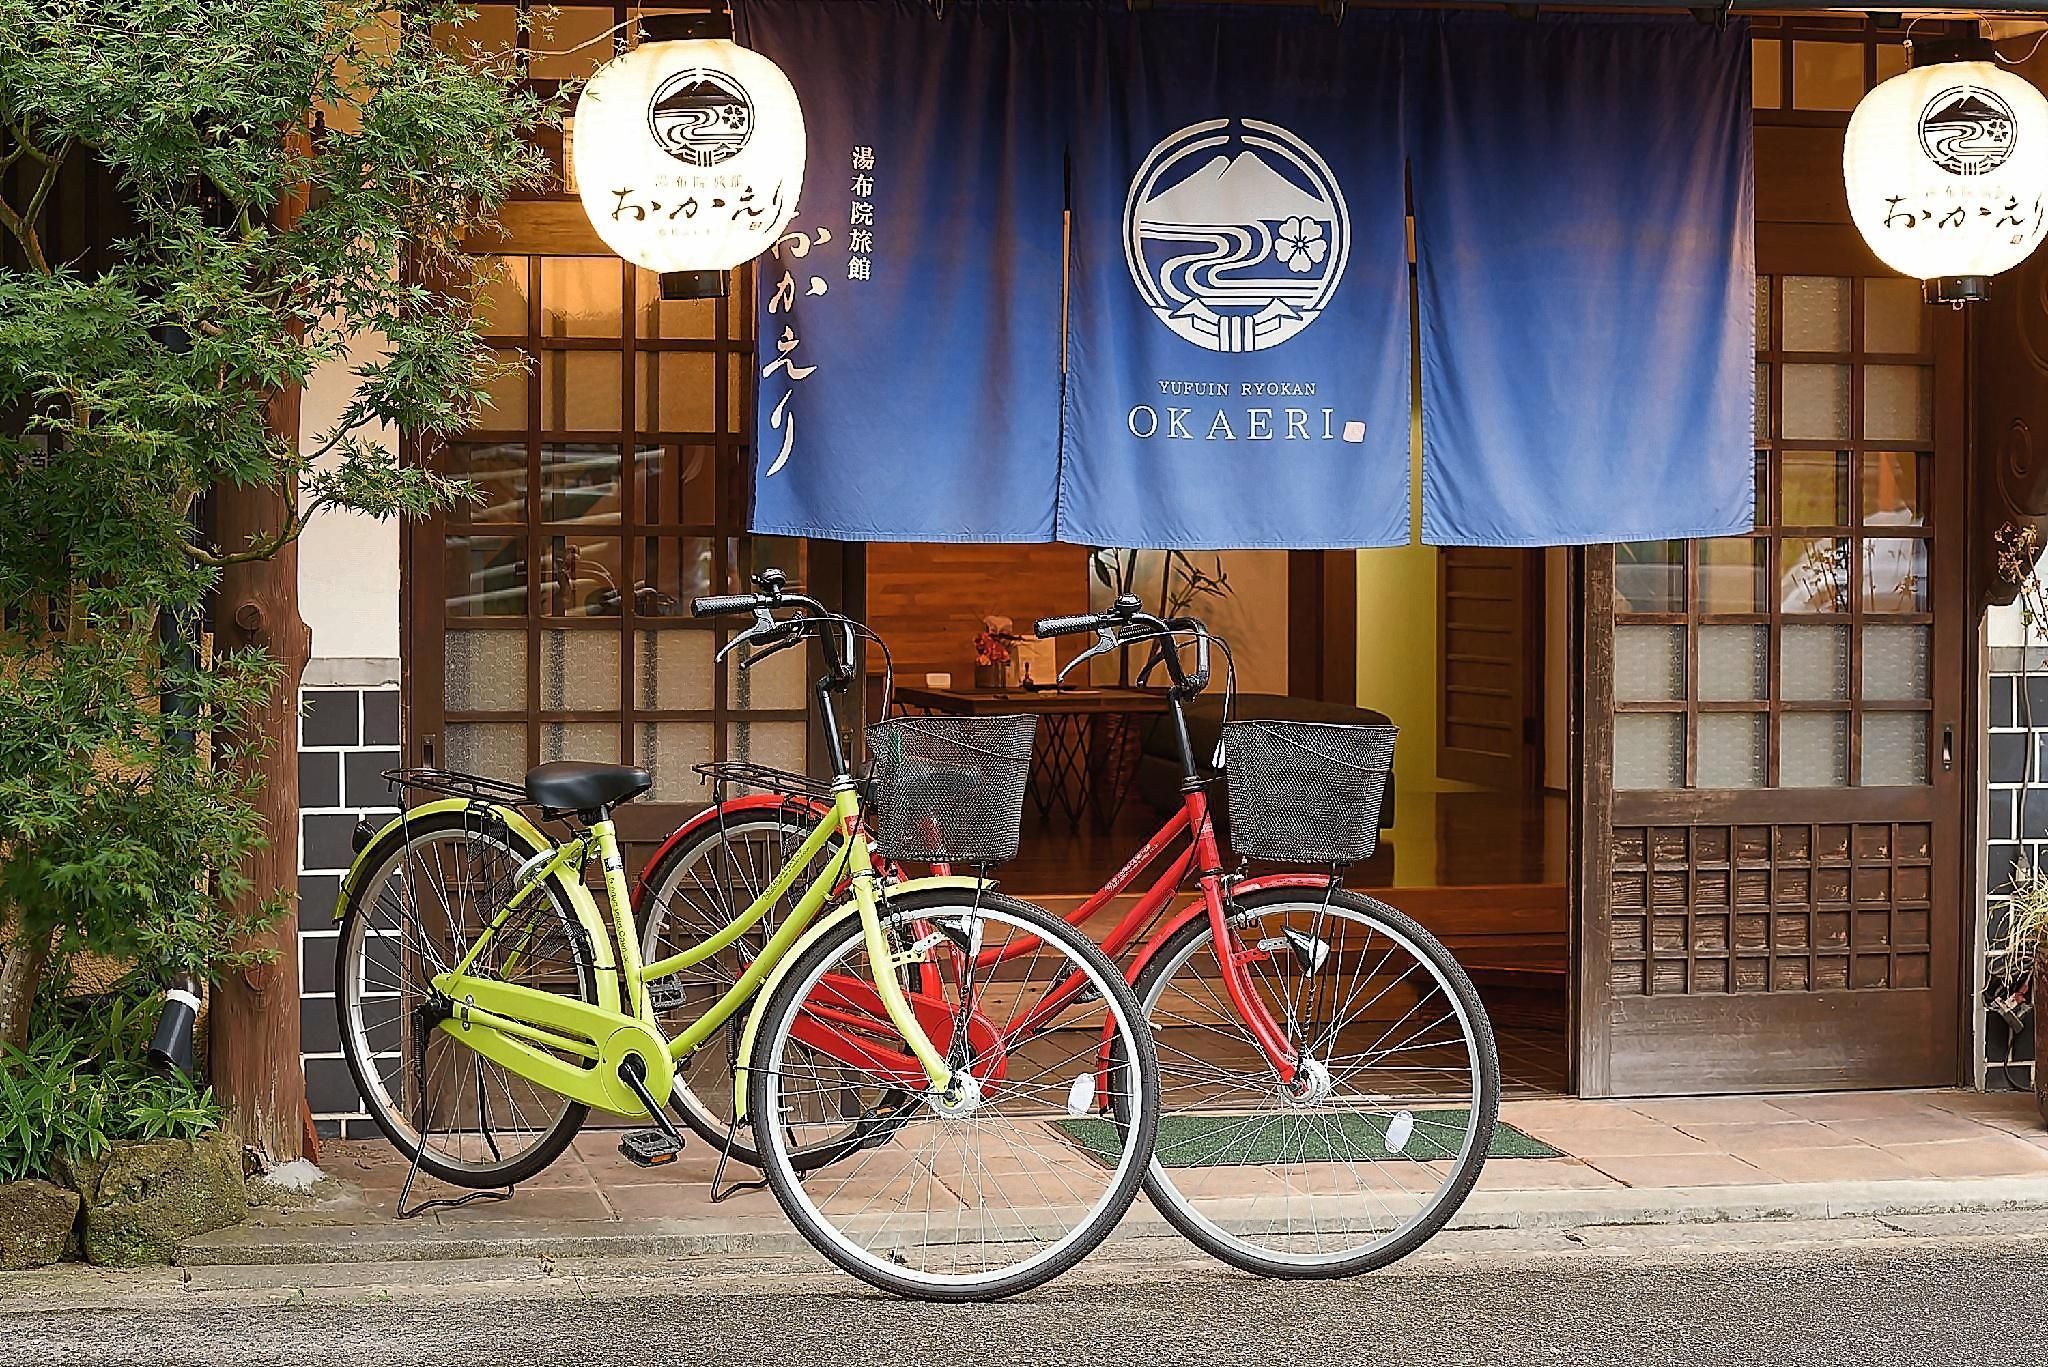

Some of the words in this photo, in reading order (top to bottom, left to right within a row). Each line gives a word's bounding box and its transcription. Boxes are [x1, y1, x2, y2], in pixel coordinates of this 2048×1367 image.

[611, 177, 783, 234] おかえり
[848, 145, 876, 282] 湯布院旅館
[1883, 191, 2044, 237] おかえり
[1158, 380, 1230, 397] YUFUIN
[1240, 382, 1317, 397] RYOKAN
[1127, 404, 1335, 441] OKAERI
